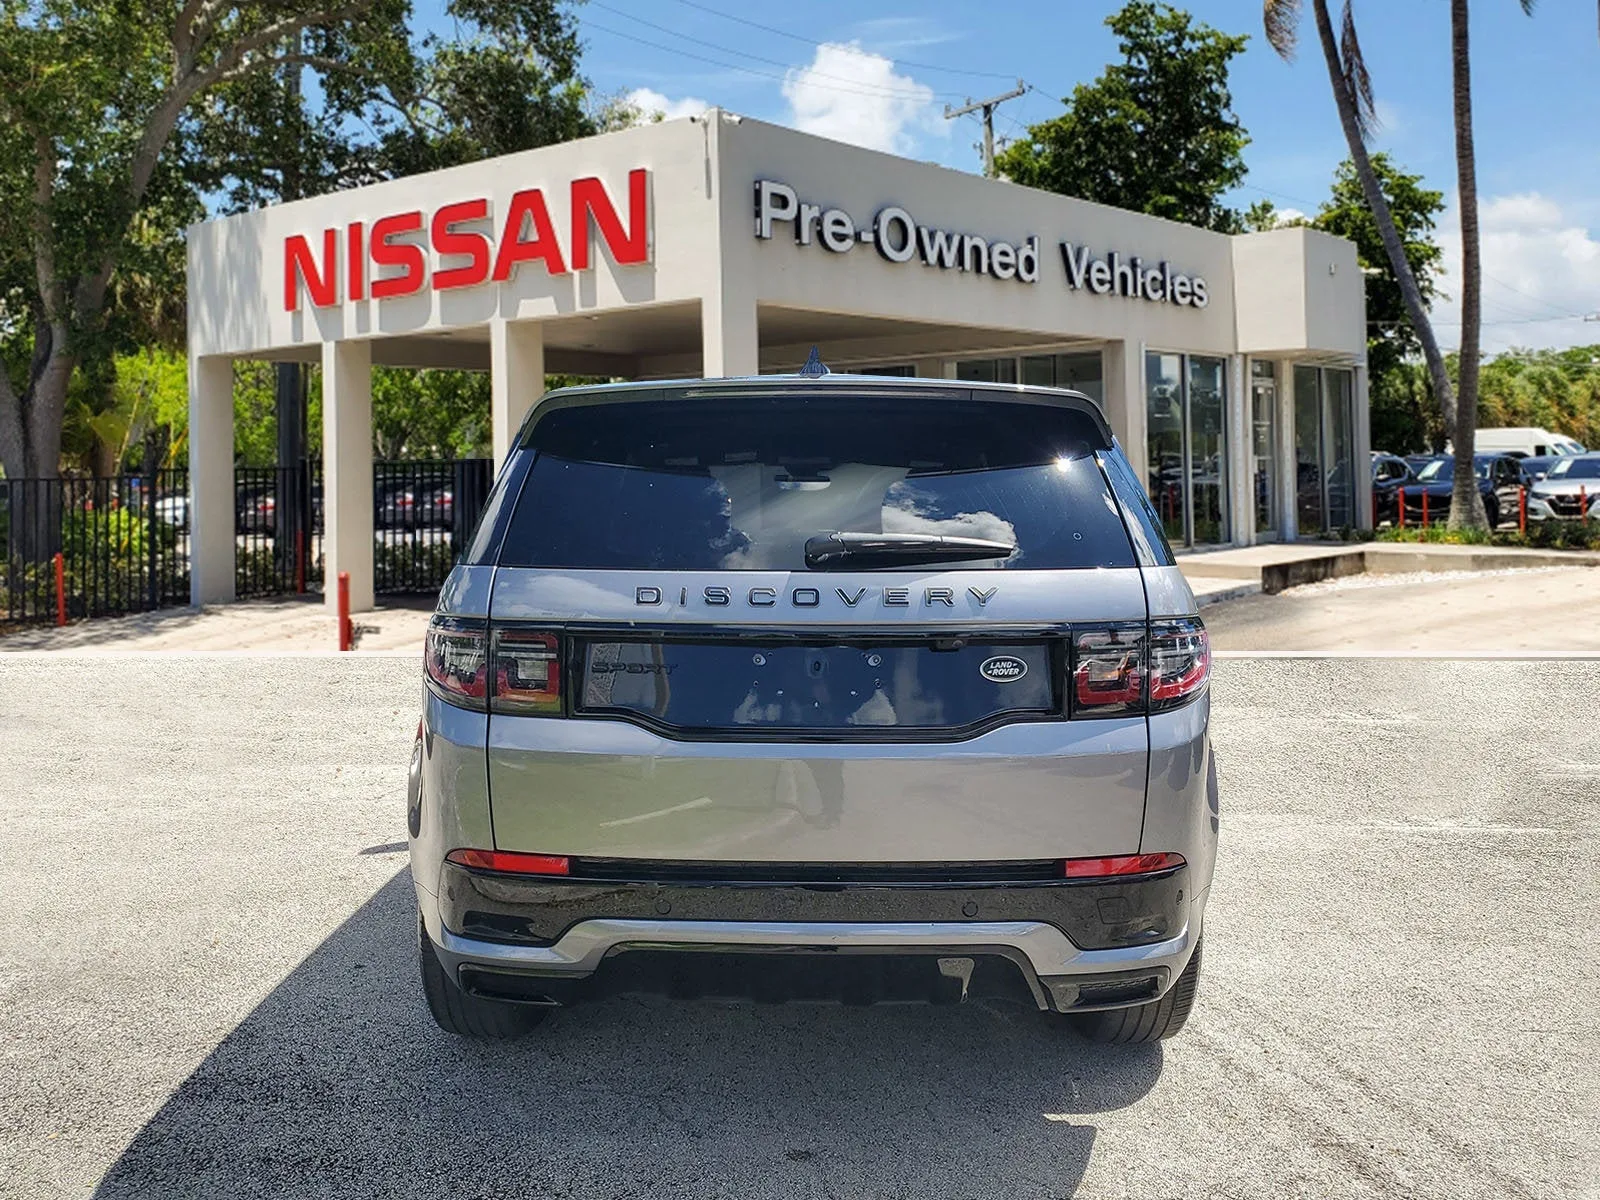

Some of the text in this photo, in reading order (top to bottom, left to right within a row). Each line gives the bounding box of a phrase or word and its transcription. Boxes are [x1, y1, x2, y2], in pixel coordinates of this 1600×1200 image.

[285, 168, 646, 312] NISSAN
[754, 179, 1209, 308] Pre-Owned Vehicles
[634, 586, 1000, 608] DISCOVERY
[591, 662, 679, 675] SPORT
[990, 661, 1012, 669] LAND
[992, 668, 1020, 676] ROVER
